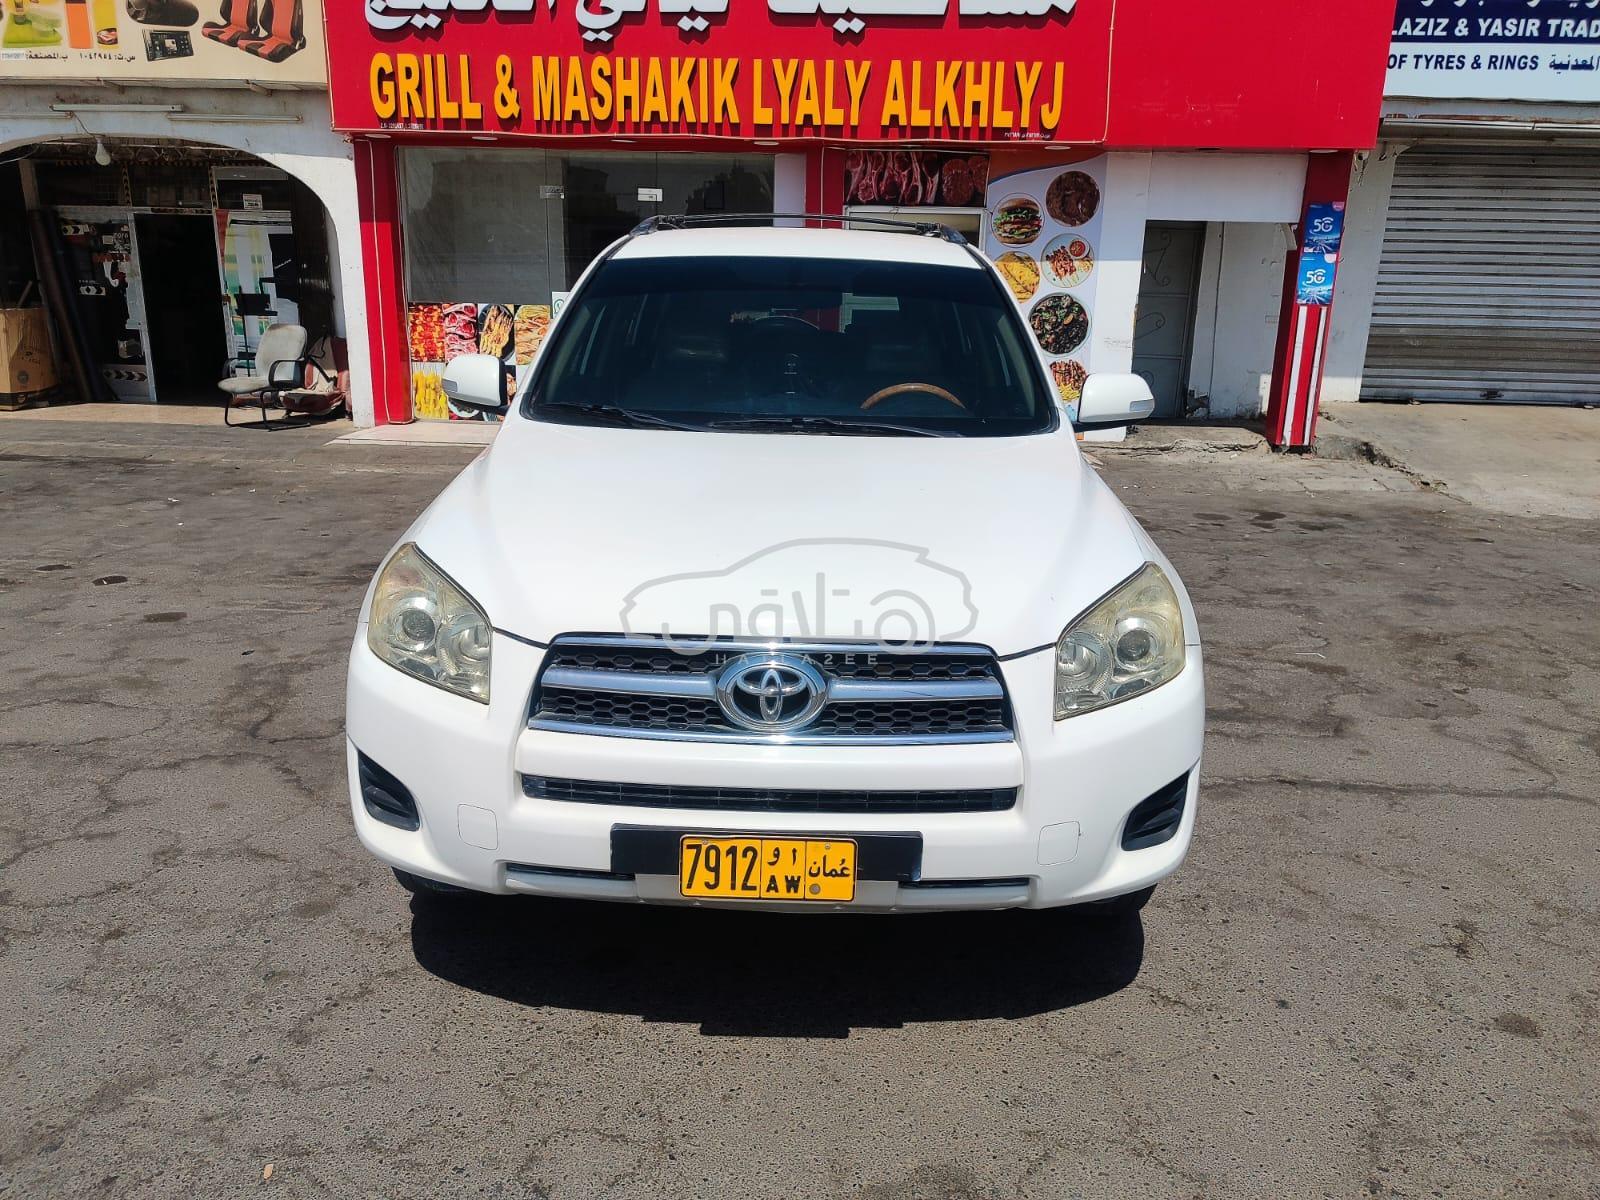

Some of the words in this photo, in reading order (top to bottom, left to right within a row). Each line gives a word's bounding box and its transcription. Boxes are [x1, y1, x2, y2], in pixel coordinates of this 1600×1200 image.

[1454, 18, 1469, 37] &
[1479, 18, 1541, 37] YASIR
[1387, 54, 1408, 70] OF
[1413, 54, 1466, 70] TYRES
[1470, 54, 1482, 70] &
[1488, 54, 1540, 71] RINGS
[370, 53, 481, 119] GRILL
[494, 55, 520, 119] &
[532, 56, 739, 123] MASHAKIK
[754, 59, 870, 125] LYALY
[882, 60, 1064, 129] ALKHLYJ
[1313, 217, 1334, 233] 5G
[1305, 269, 1327, 284] 5G
[685, 844, 759, 892] 7912
